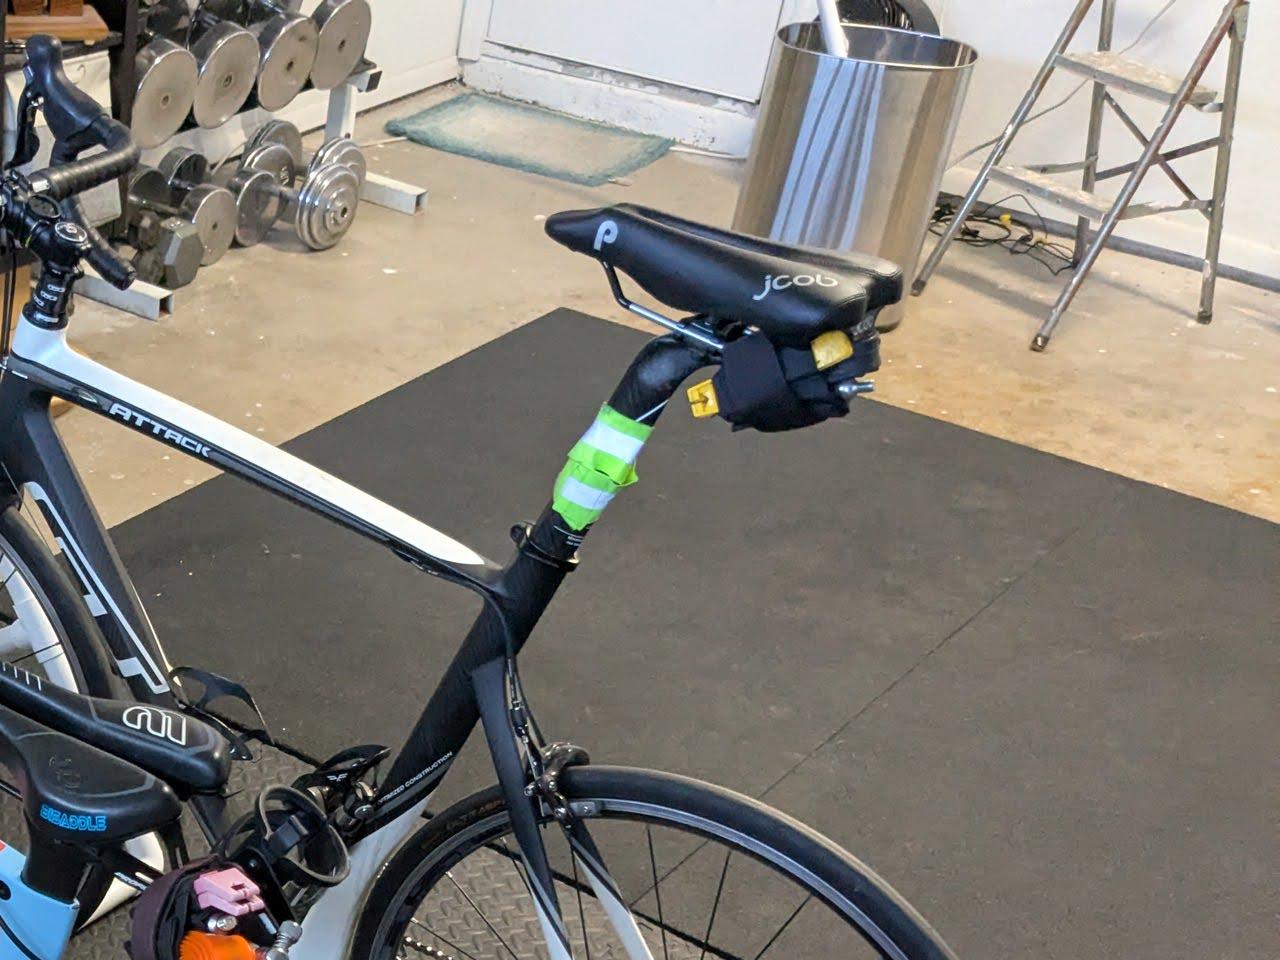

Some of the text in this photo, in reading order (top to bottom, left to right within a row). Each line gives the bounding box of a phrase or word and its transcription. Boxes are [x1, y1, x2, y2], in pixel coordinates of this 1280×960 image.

[107, 400, 213, 458] ATTACK
[403, 749, 454, 788] CONSTRUCTION
[39, 802, 108, 832] BISADDLE
